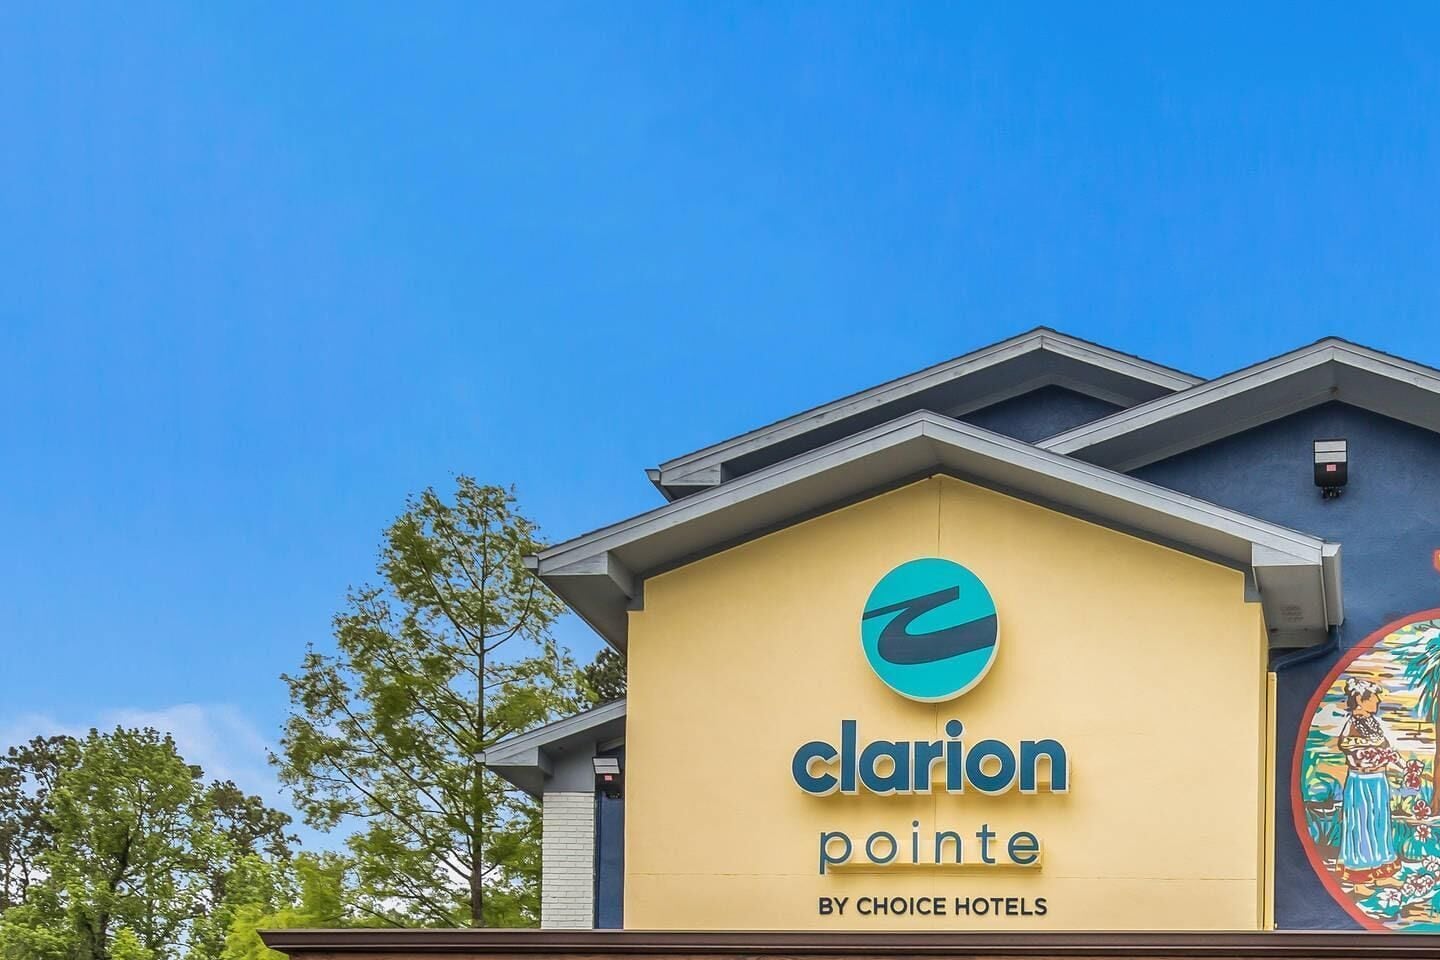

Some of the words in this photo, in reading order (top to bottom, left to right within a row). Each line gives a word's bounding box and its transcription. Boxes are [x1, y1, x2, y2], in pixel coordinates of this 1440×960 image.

[791, 719, 1069, 794] clarion
[819, 820, 1041, 875] pointe
[819, 897, 849, 916] BY
[856, 896, 947, 916] CHOICE
[955, 897, 1048, 916] HOTELS
